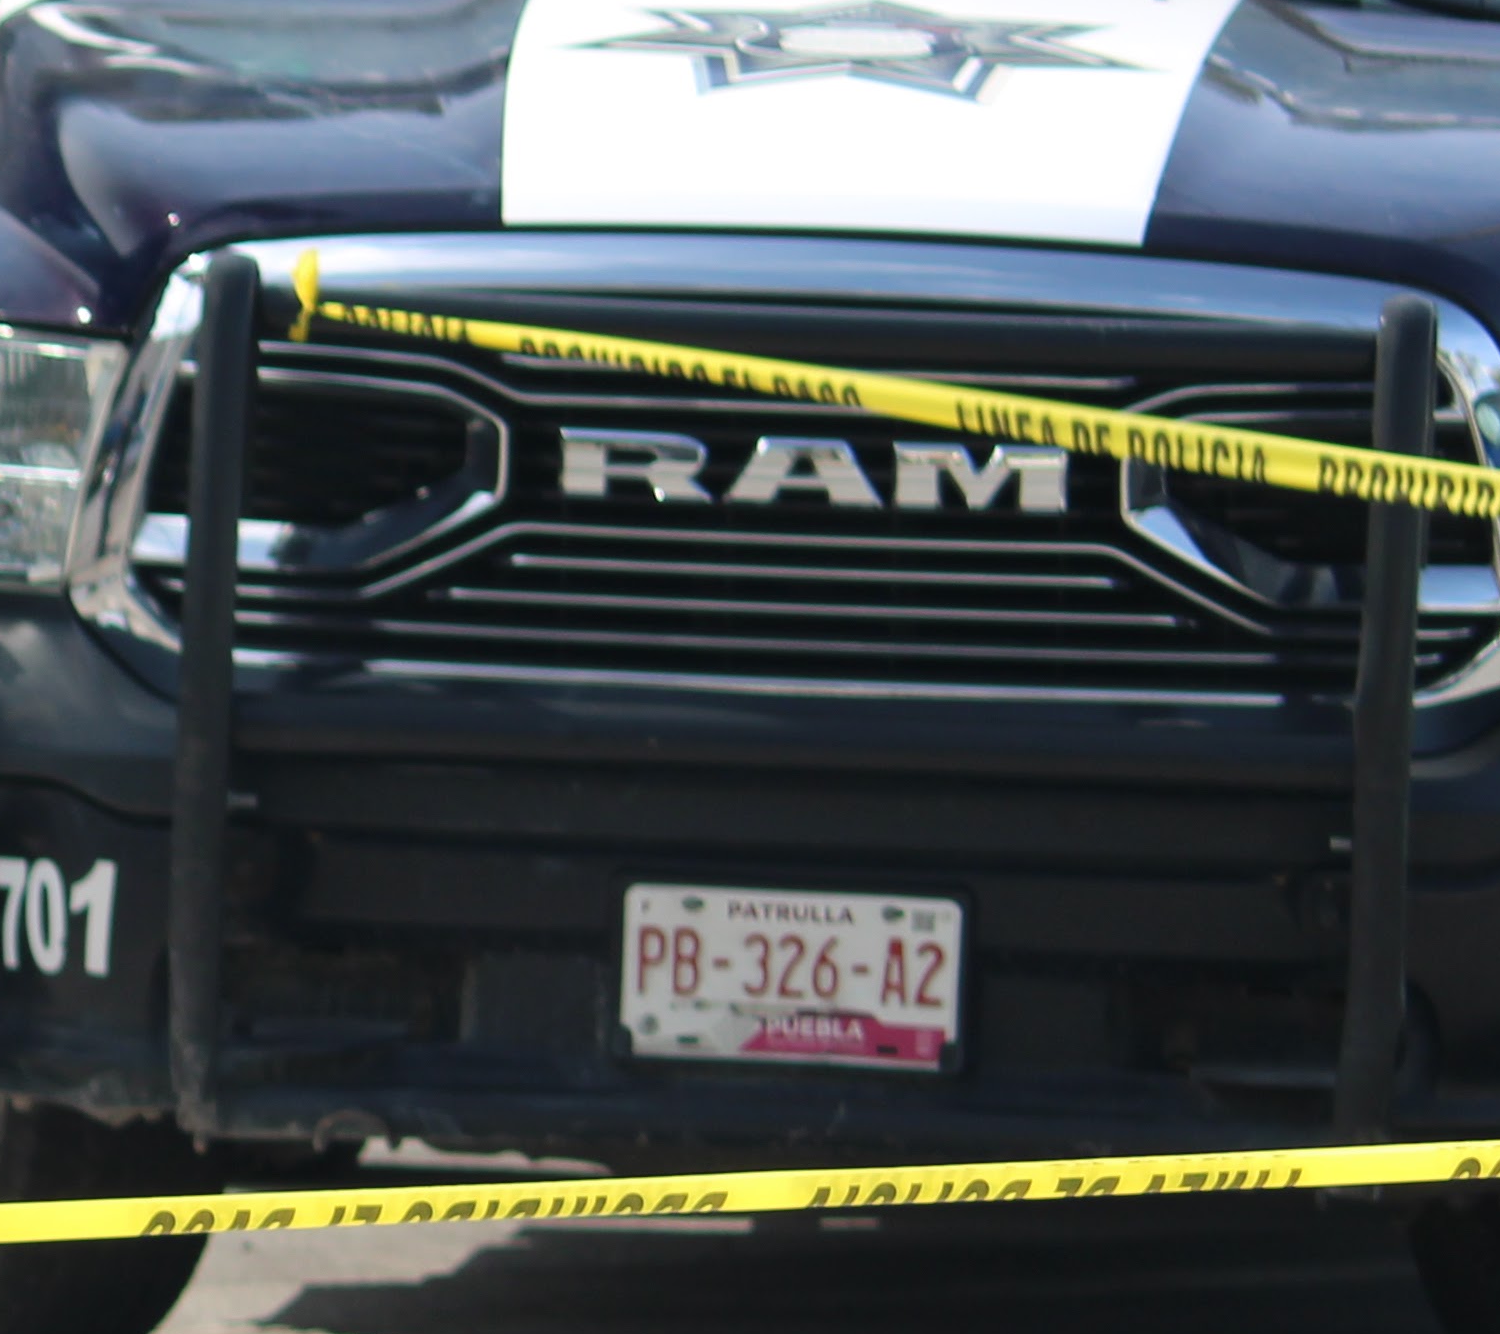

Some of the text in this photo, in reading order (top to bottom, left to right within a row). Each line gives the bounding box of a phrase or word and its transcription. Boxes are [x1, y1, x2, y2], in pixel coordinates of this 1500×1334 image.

[559, 426, 1067, 514] RAM
[727, 898, 855, 925] PATRULLA
[635, 925, 947, 1008] PB-326-A2
